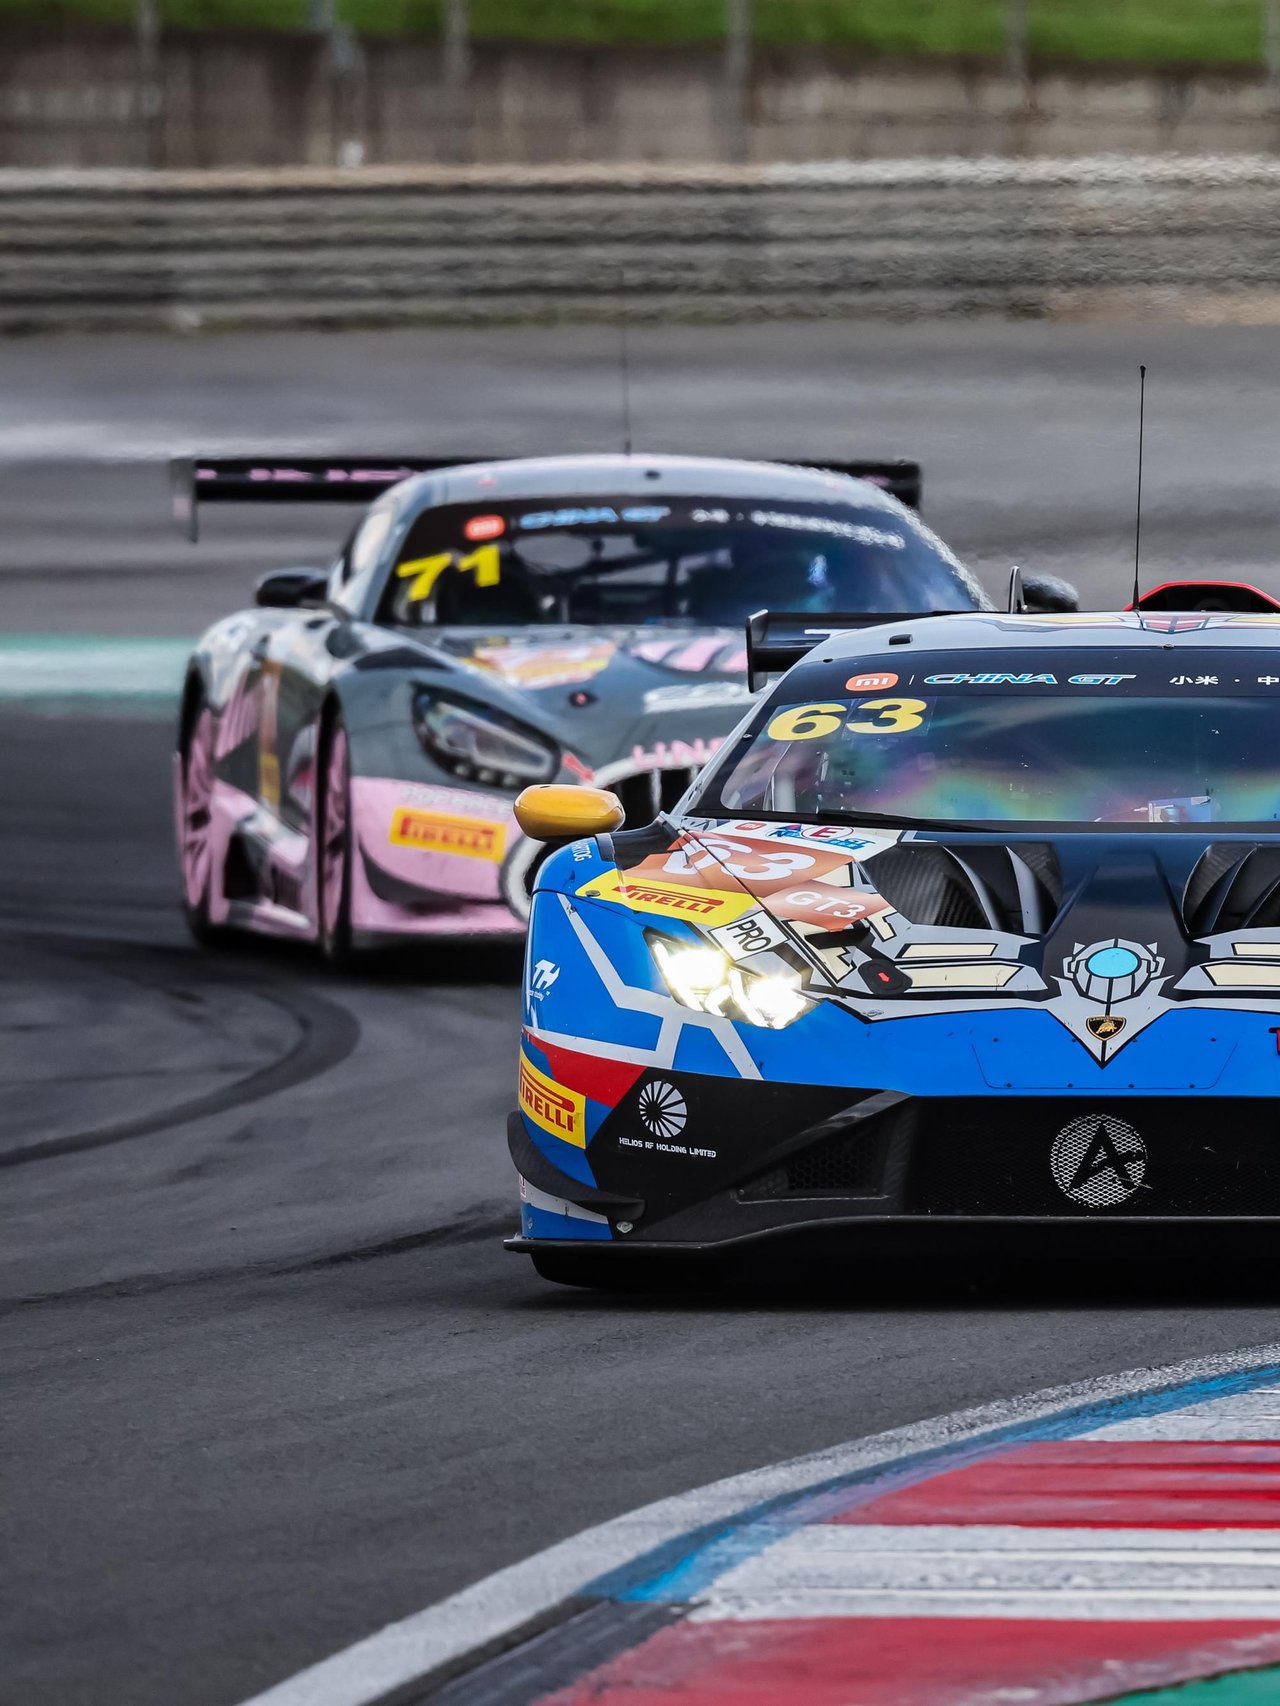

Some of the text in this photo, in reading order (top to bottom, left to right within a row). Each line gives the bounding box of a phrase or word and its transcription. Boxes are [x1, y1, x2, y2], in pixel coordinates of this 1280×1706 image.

[397, 544, 500, 601] 71
[924, 673, 1136, 685] CHINA GT
[1169, 675, 1219, 686] 小米
[767, 698, 927, 741] 63
[400, 816, 495, 849] PIRELLI
[662, 838, 816, 881] 63
[612, 884, 725, 914] PIRELLI
[785, 890, 867, 918] GT3
[726, 919, 772, 953] PRO
[619, 1137, 717, 1158] HELIOS RF HOLDING LIMITED
